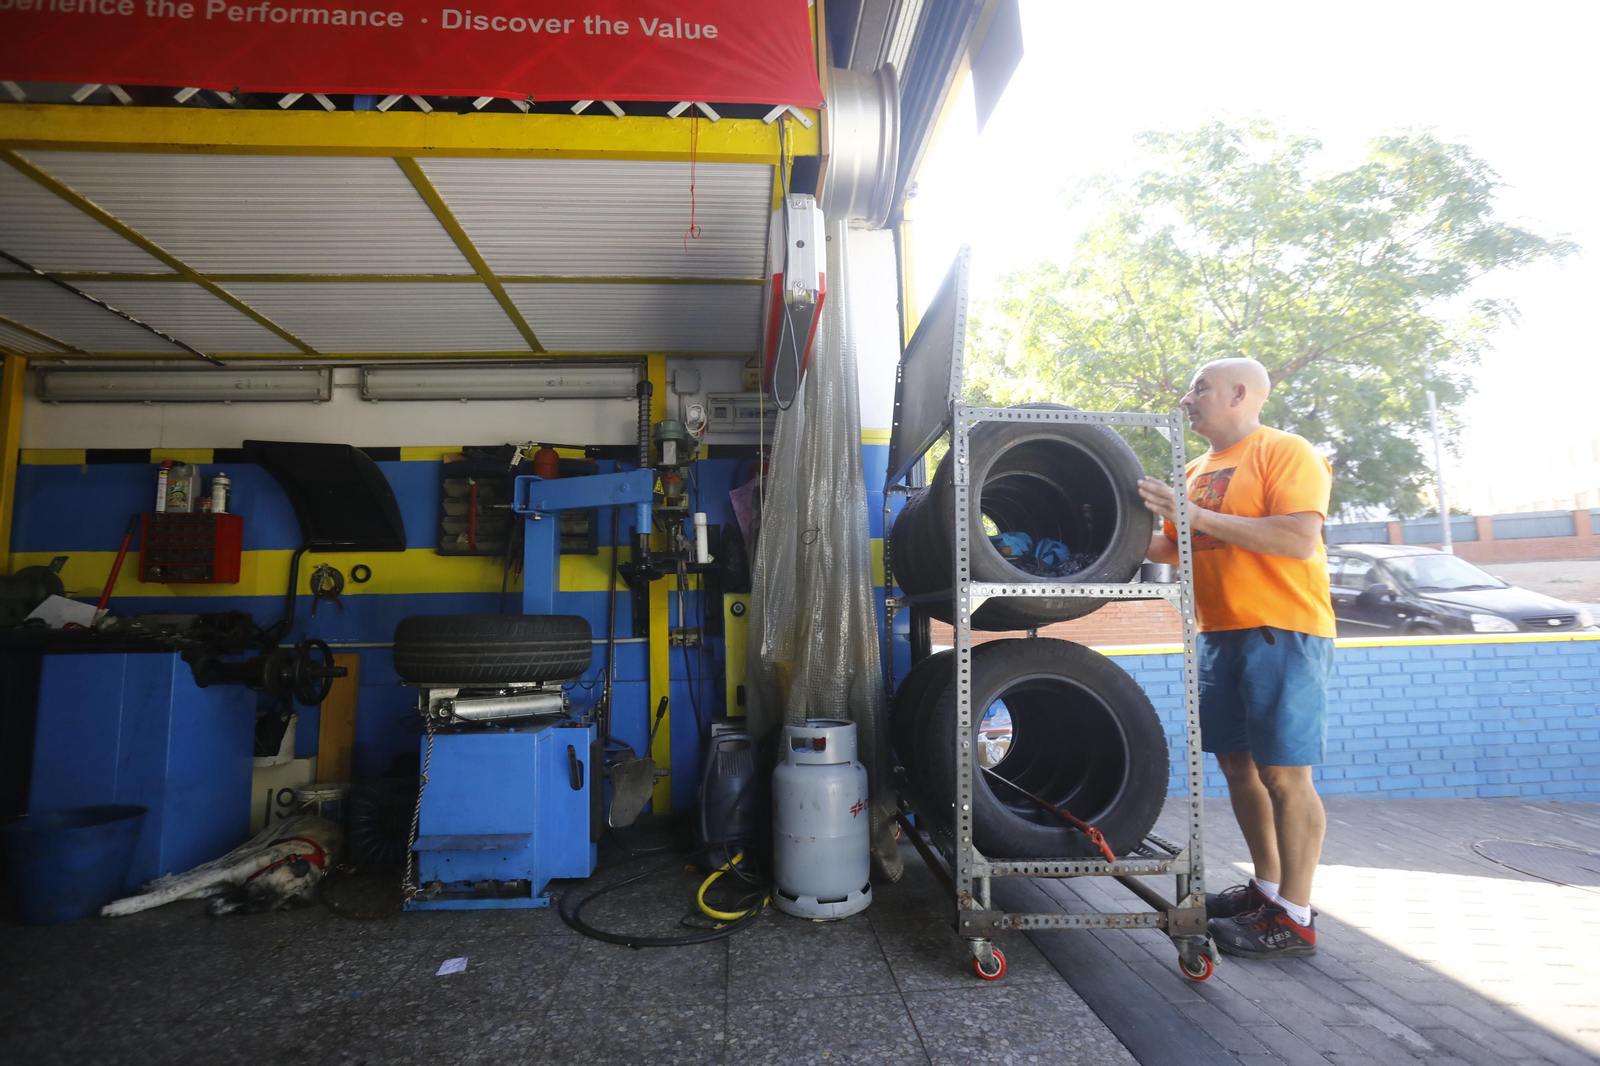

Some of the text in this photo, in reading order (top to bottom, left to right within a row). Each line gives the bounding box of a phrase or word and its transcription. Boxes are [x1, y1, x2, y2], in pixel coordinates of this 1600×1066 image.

[146, 0, 194, 18] the
[206, 0, 404, 27] Performance
[441, 9, 575, 34] Discover
[583, 15, 629, 35] the
[639, 17, 718, 39] Value
